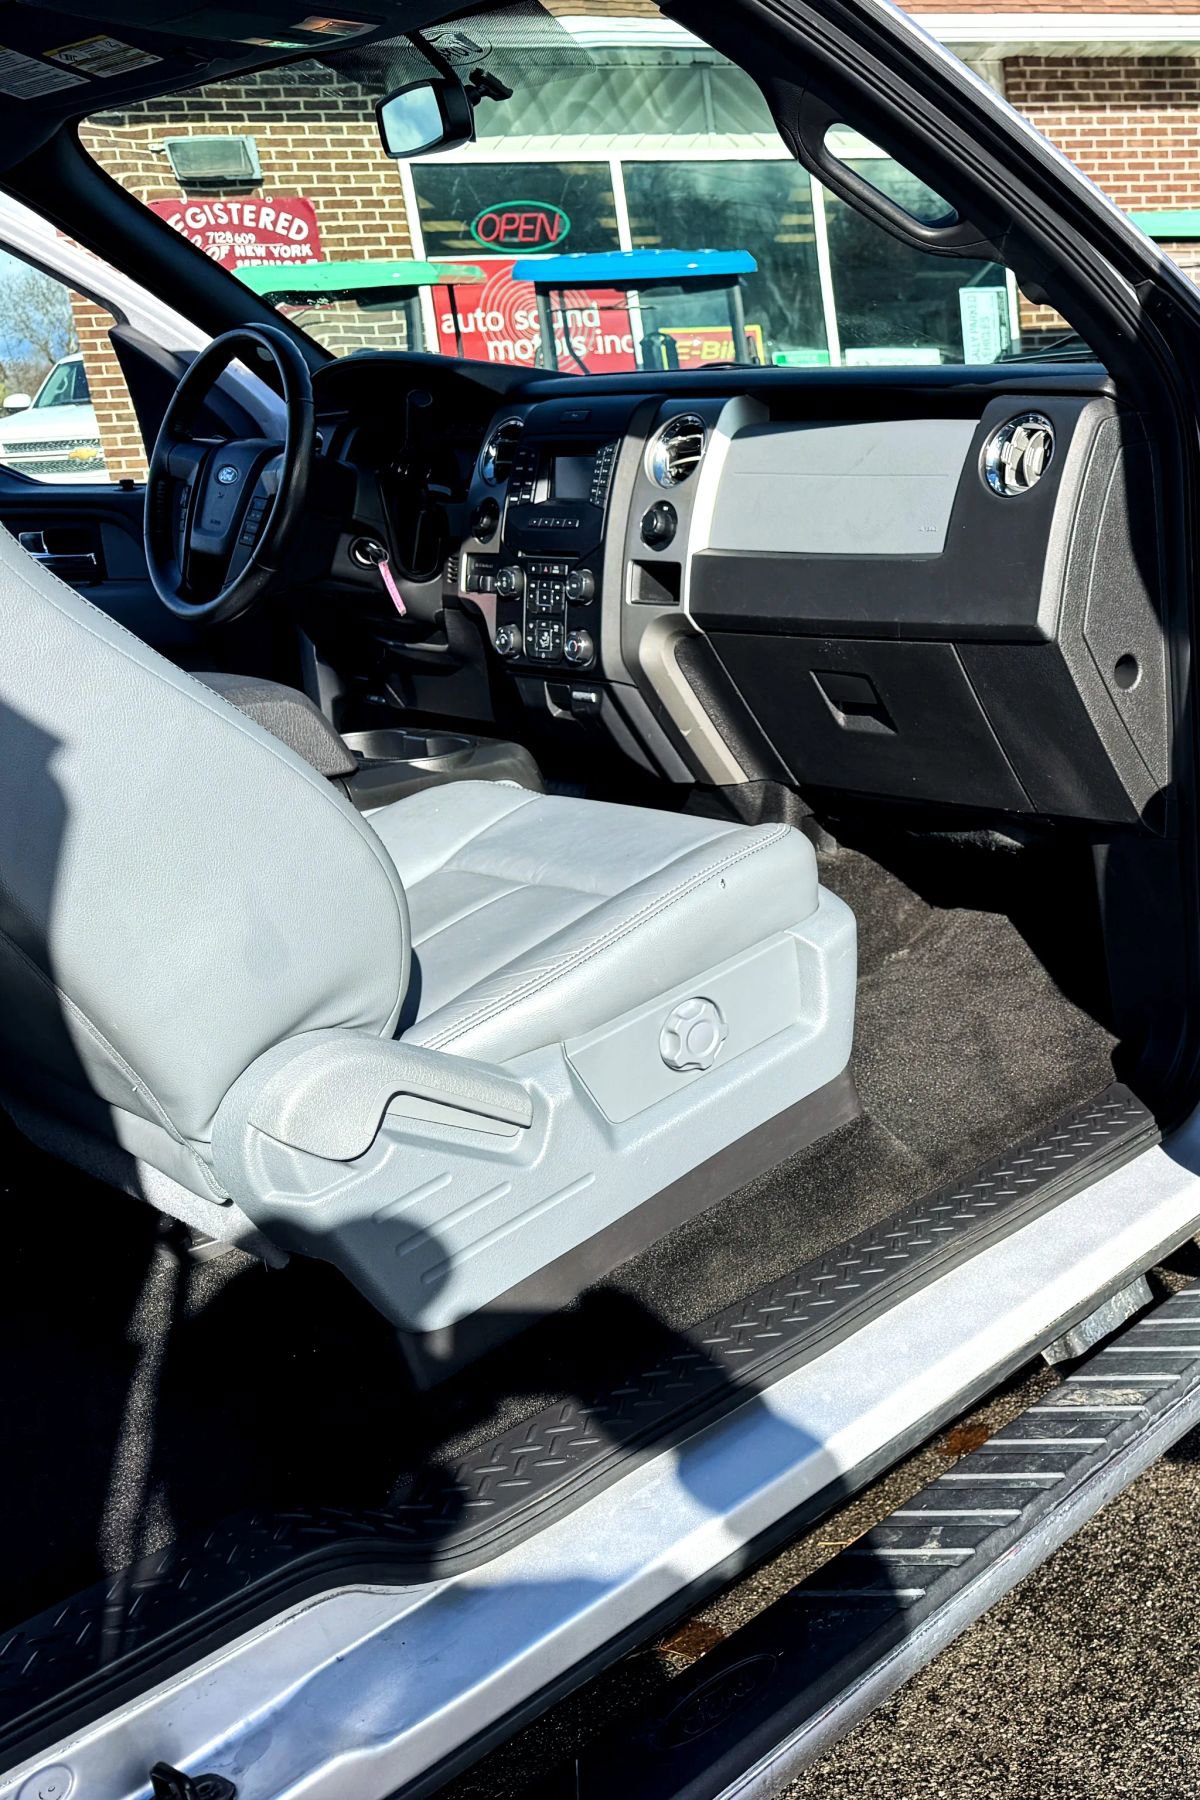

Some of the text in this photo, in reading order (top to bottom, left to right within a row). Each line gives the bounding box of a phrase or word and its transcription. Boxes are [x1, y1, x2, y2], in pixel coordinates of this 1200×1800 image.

[477, 212, 561, 243] OPEN
[235, 245, 268, 258] NEW
[269, 243, 314, 259] YORK
[441, 301, 601, 334] auto sound
